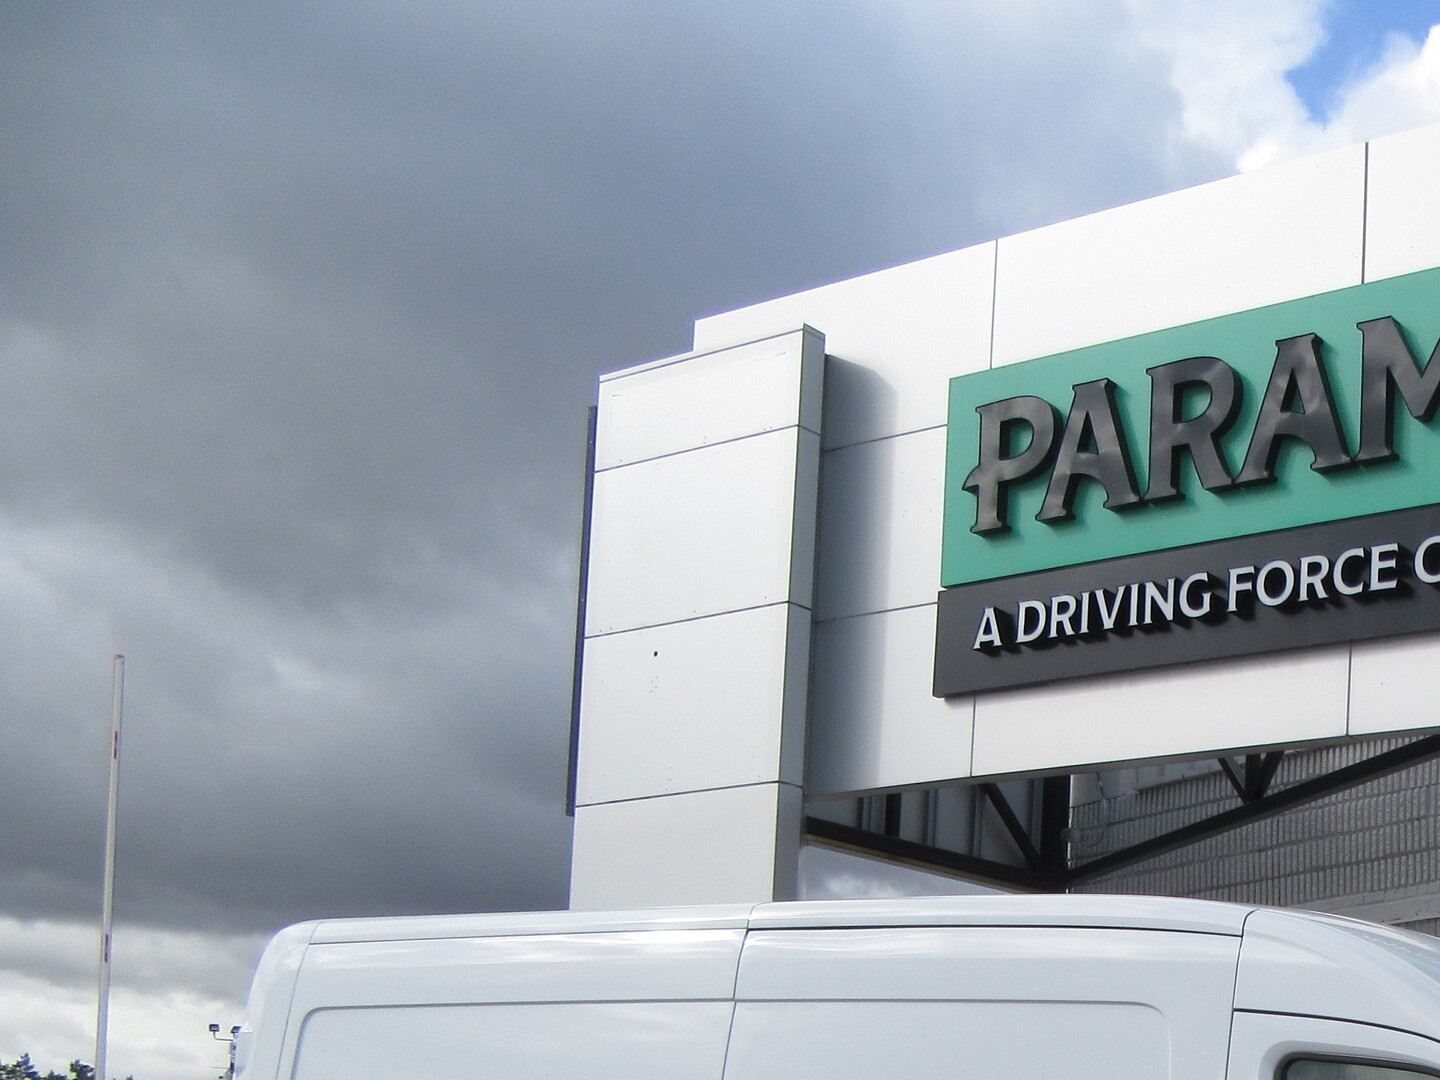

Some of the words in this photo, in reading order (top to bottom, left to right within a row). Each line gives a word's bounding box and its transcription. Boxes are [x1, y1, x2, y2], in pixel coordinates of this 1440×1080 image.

[973, 606, 1002, 649] A
[1015, 572, 1211, 644] DRIVING
[1227, 543, 1399, 612] FORCE
